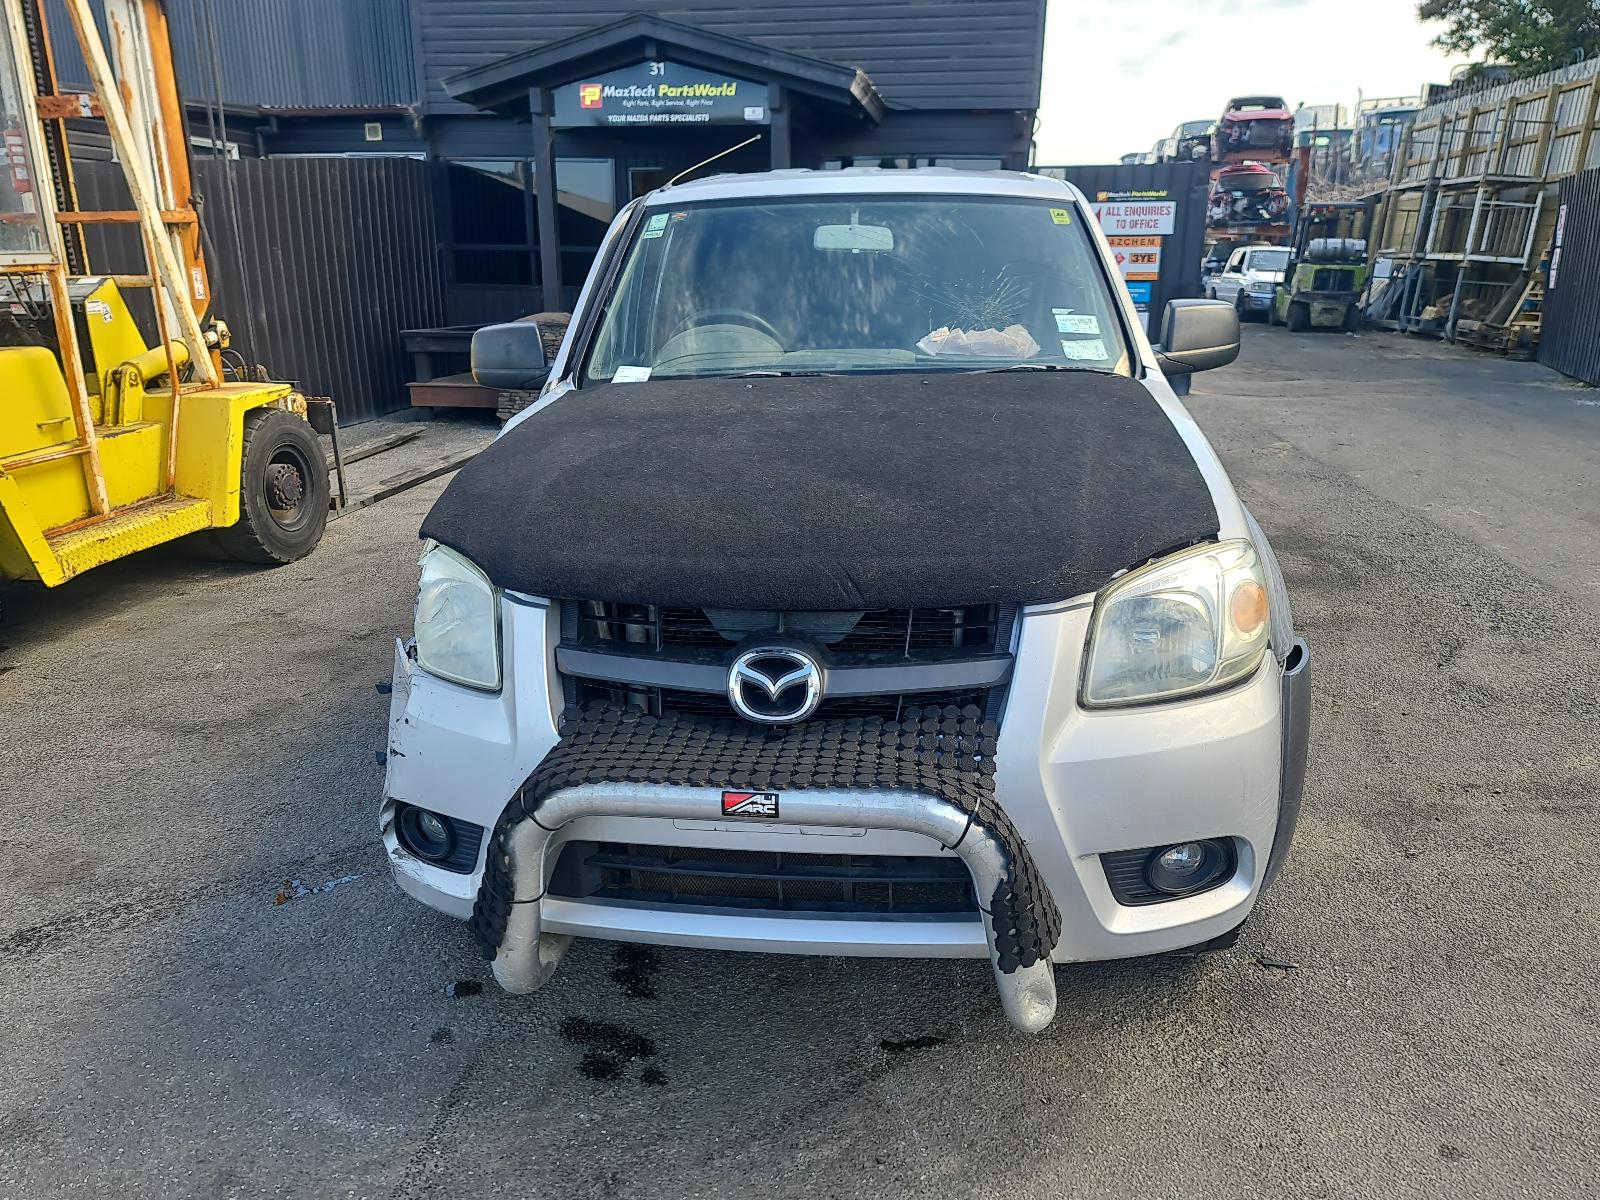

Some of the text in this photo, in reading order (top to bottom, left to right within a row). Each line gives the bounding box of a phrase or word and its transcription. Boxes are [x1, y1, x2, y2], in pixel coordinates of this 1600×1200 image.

[649, 62, 664, 75] 31
[603, 84, 656, 97] MazTech
[658, 82, 737, 97] PartsWorld
[649, 114, 669, 122] PARTS
[670, 113, 710, 122] SPECIALISTS
[1106, 206, 1171, 216] ALL ENQUIRIES
[1116, 219, 1159, 229] TO OFFICE
[1109, 238, 1155, 246] AZCHEM
[1131, 254, 1155, 263] 3YE
[734, 804, 776, 814] ARC
